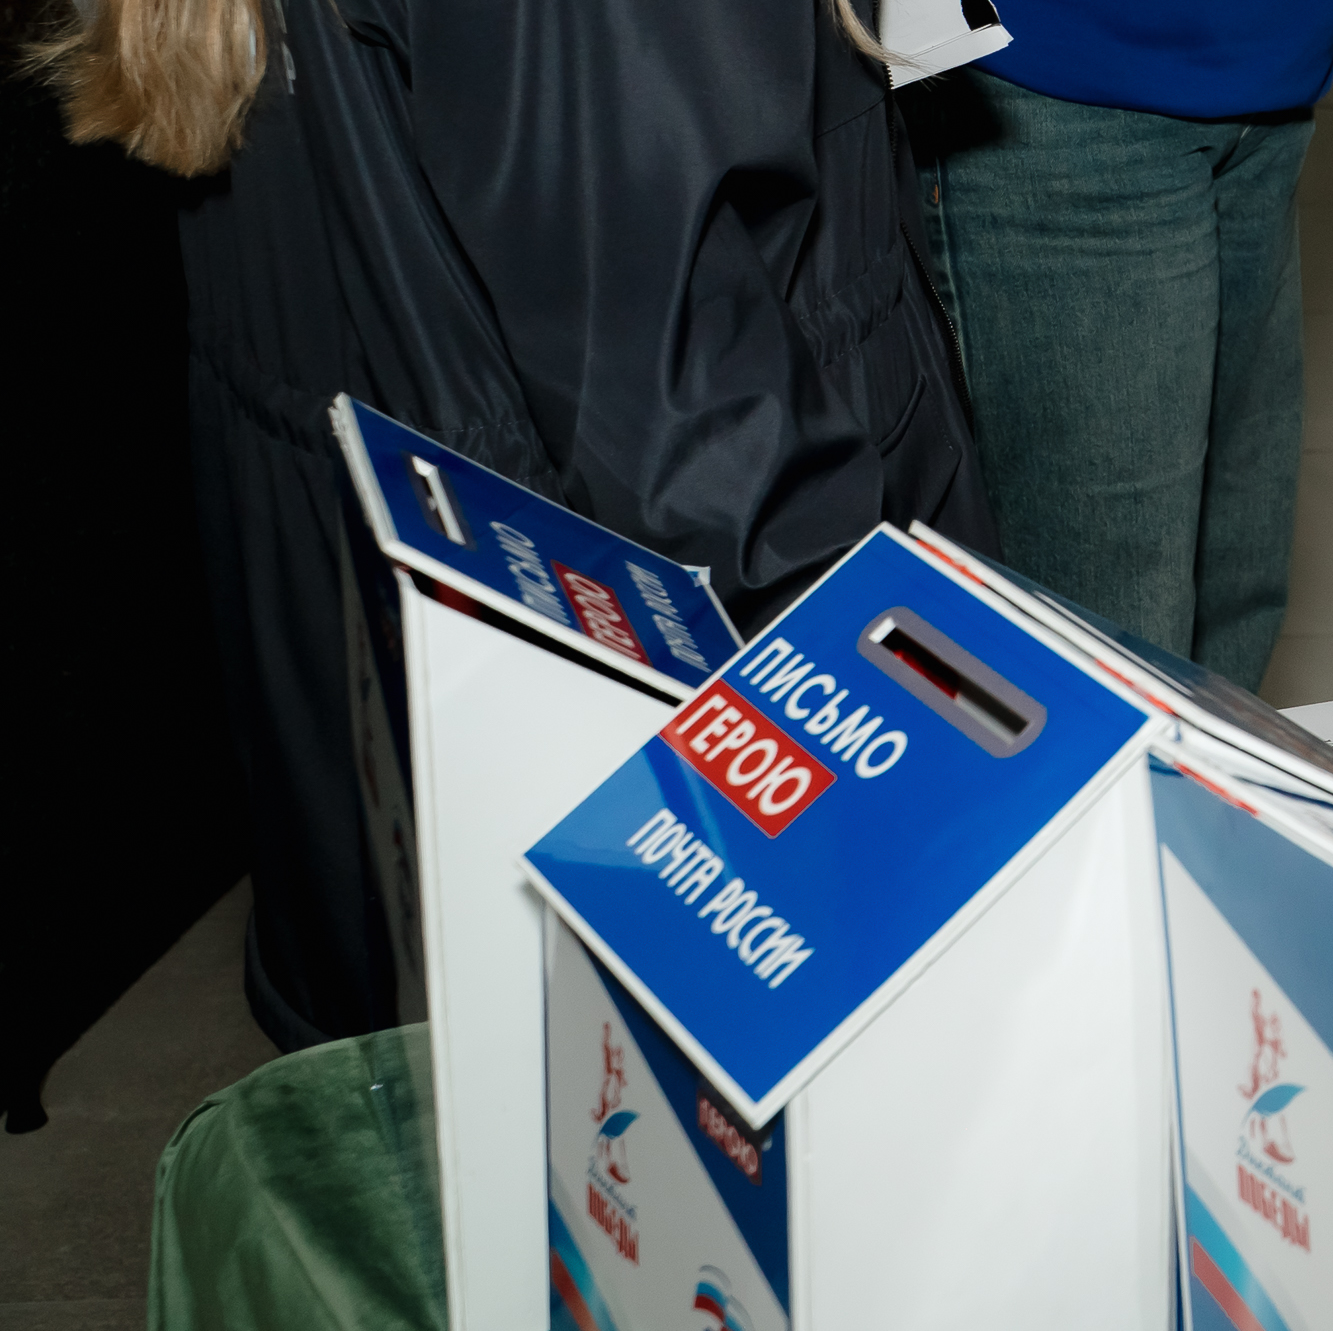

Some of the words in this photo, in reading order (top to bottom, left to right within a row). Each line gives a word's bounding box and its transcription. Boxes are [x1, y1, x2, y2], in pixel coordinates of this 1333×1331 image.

[673, 693, 813, 819] ГЕРОЮ
[737, 636, 908, 780] ПИСЬМО
[627, 807, 718, 906] ПОЧТА
[697, 876, 815, 989] РОССИИ
